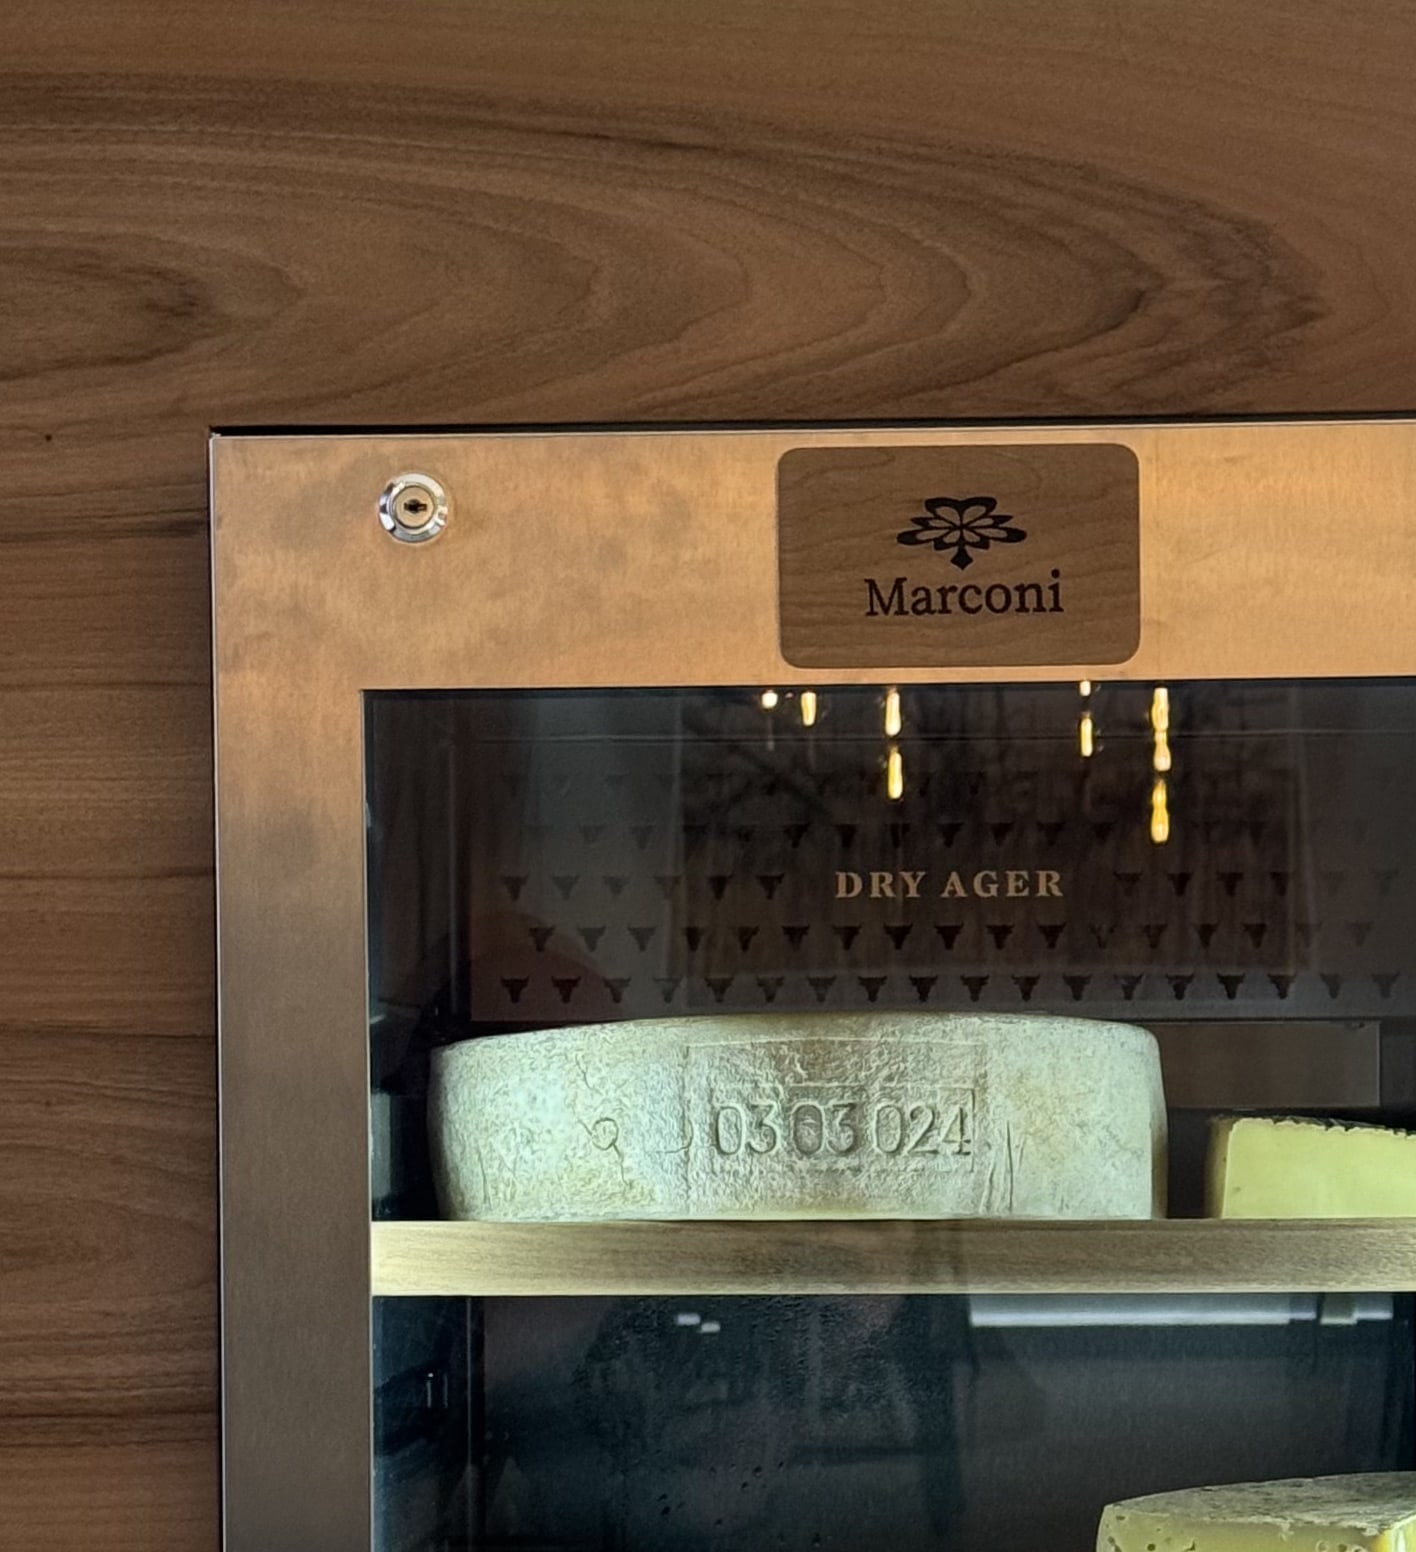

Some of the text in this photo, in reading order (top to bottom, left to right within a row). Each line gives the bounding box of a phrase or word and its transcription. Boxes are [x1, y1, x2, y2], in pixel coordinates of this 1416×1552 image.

[865, 569, 1064, 616] Marconi
[835, 870, 1063, 898] DRY AGER
